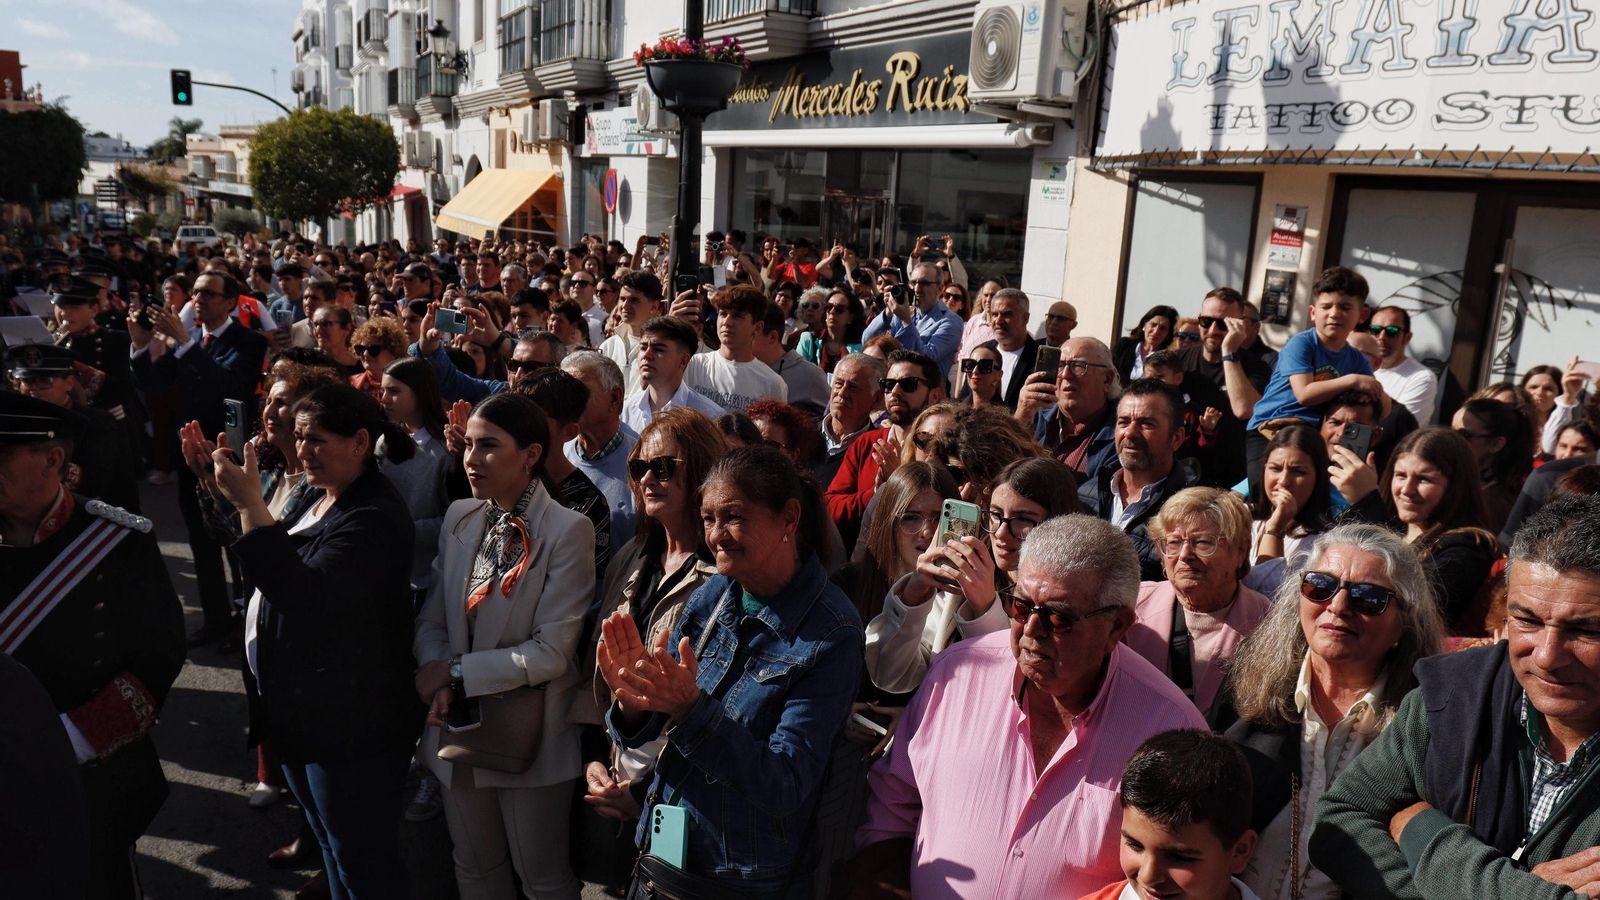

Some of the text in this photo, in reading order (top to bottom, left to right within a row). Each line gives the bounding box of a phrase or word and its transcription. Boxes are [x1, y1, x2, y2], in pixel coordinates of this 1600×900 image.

[768, 66, 882, 124] Mercedes
[886, 51, 970, 115] Ruiz
[1204, 100, 1415, 132] TATTOO
